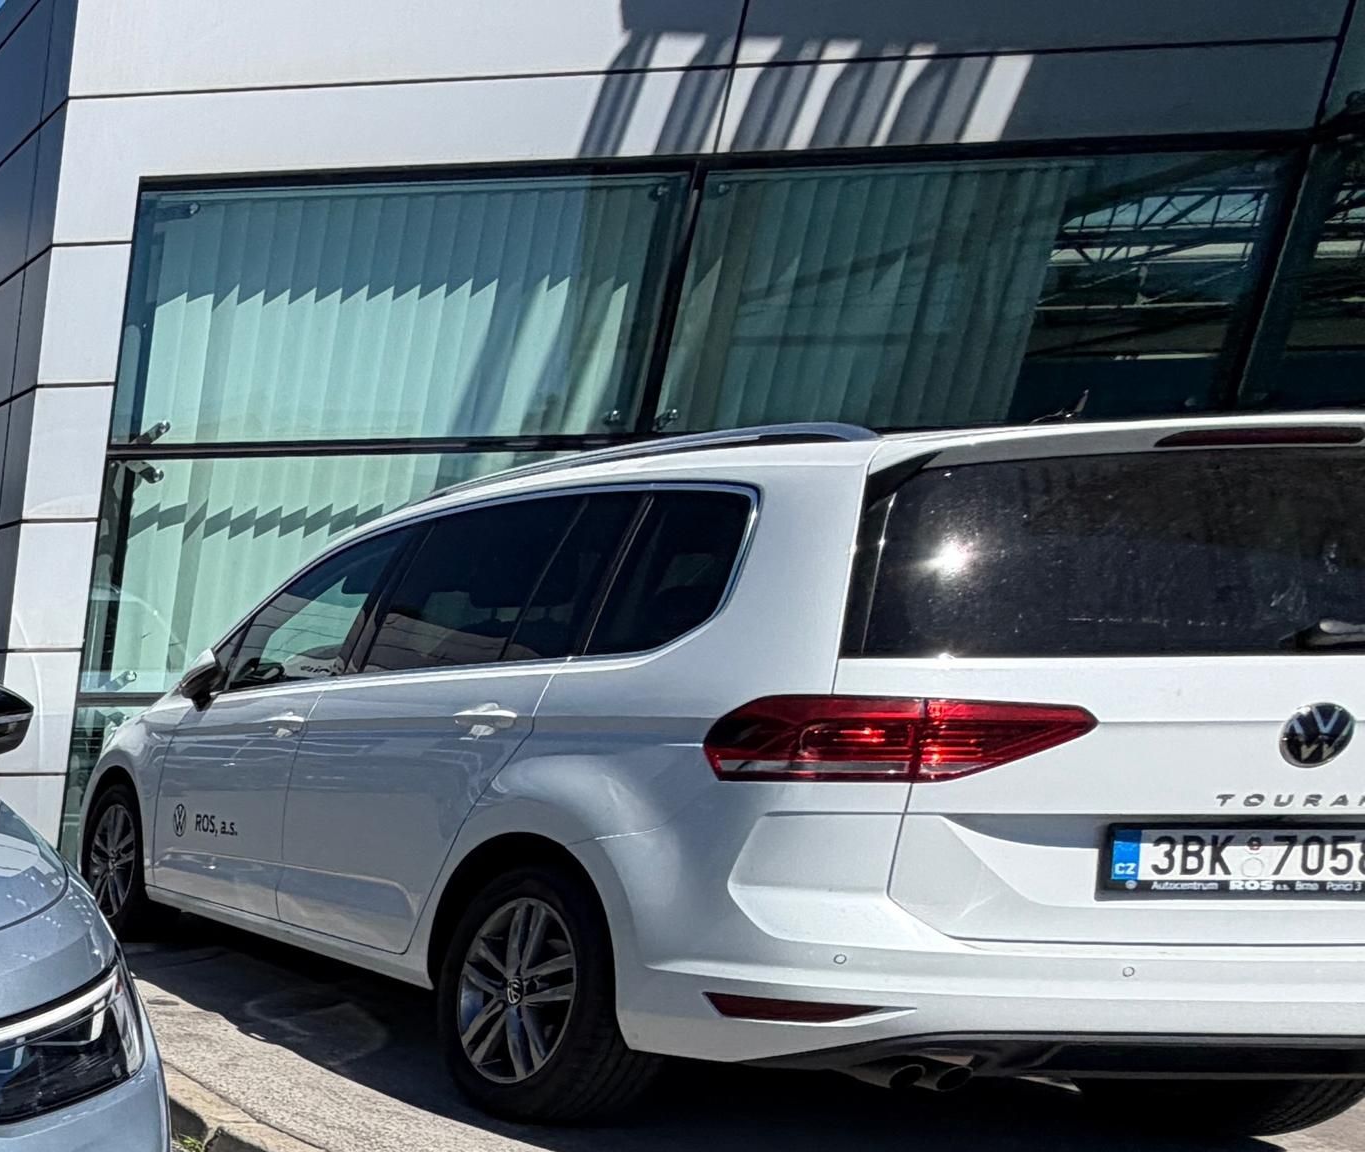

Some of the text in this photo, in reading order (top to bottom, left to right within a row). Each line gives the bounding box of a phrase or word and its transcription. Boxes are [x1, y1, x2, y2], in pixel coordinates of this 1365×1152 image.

[194, 813, 238, 837] ROS, a.s.
[1151, 835, 1235, 876] 3BK
[1114, 863, 1136, 875] CZ
[1229, 880, 1274, 890] ROS
